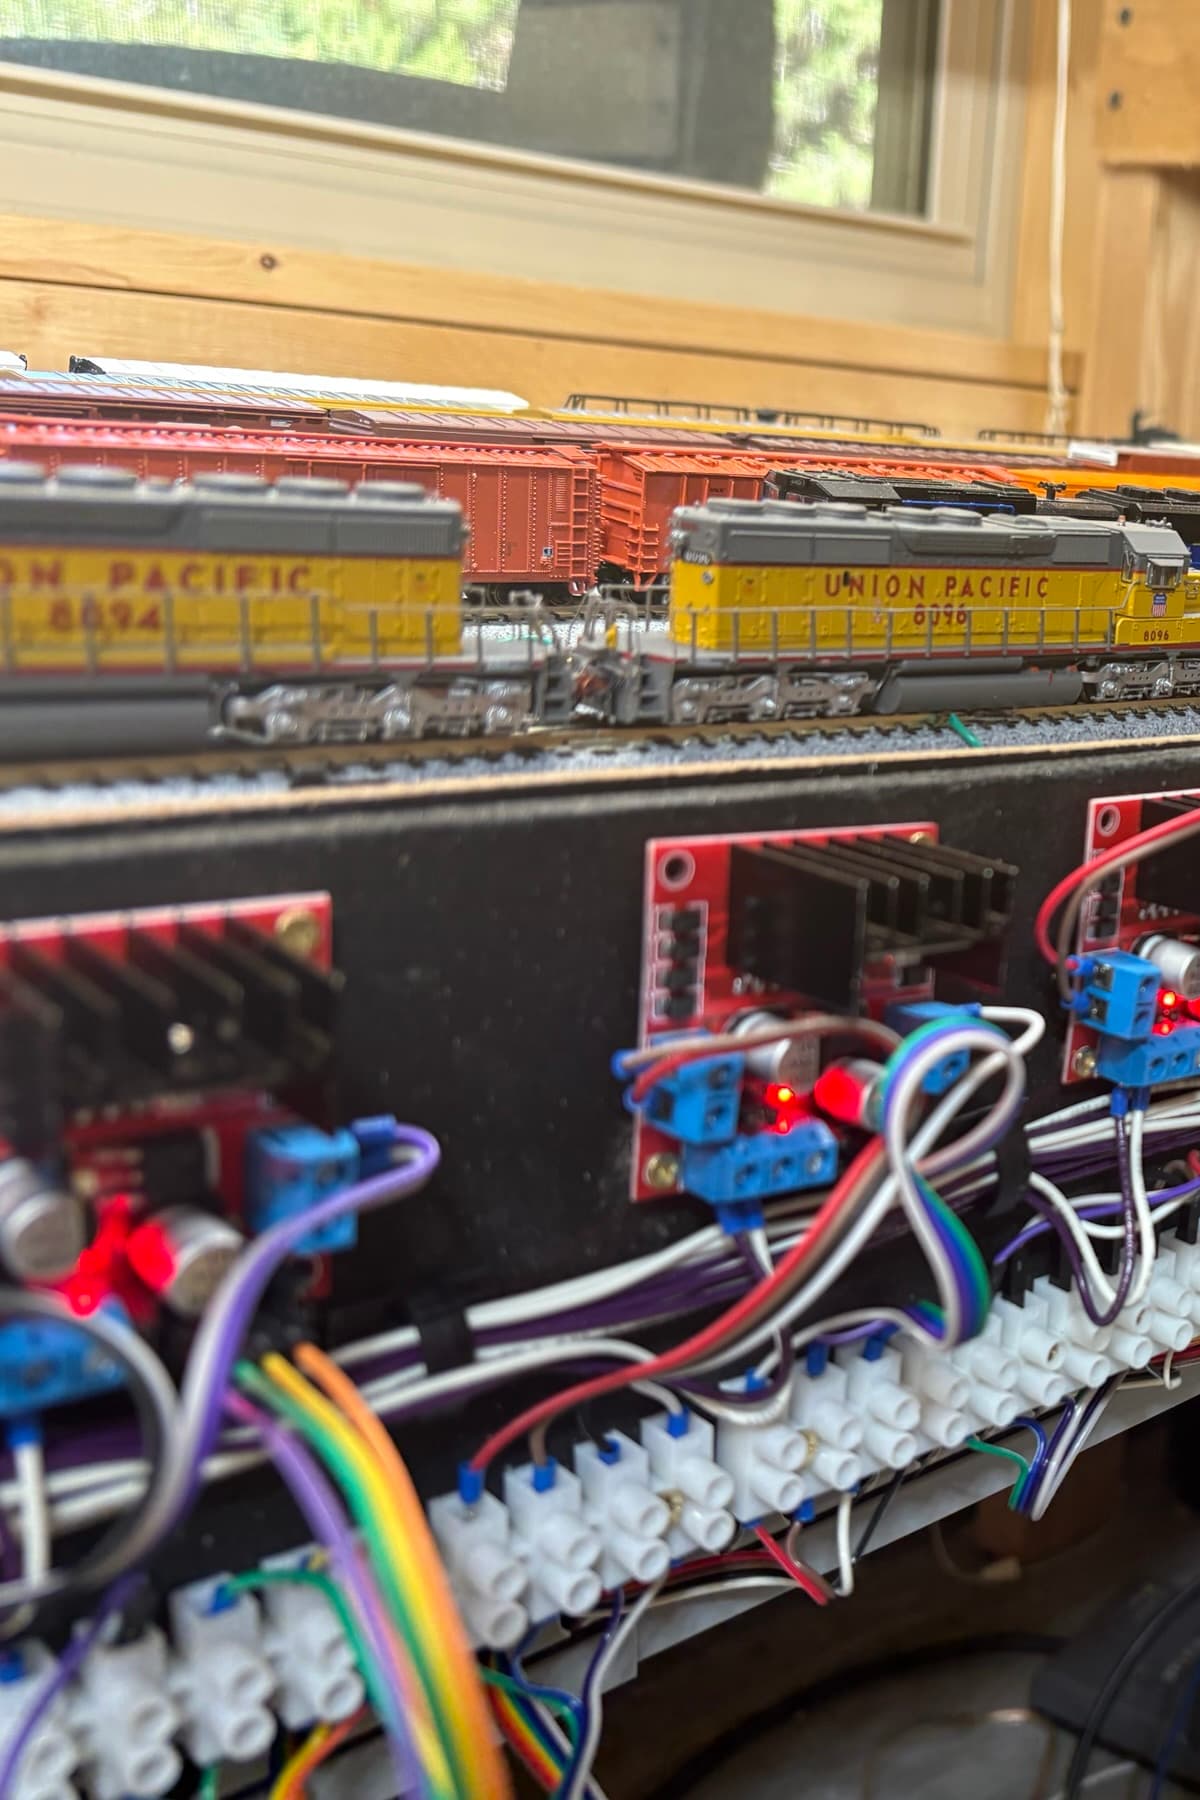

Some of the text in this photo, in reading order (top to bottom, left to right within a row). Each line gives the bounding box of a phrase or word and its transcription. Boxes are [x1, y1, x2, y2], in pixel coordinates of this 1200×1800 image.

[109, 560, 311, 592] PACIFIC
[824, 573, 1049, 599] UNION PACIFIC
[1143, 630, 1169, 642] 8096
